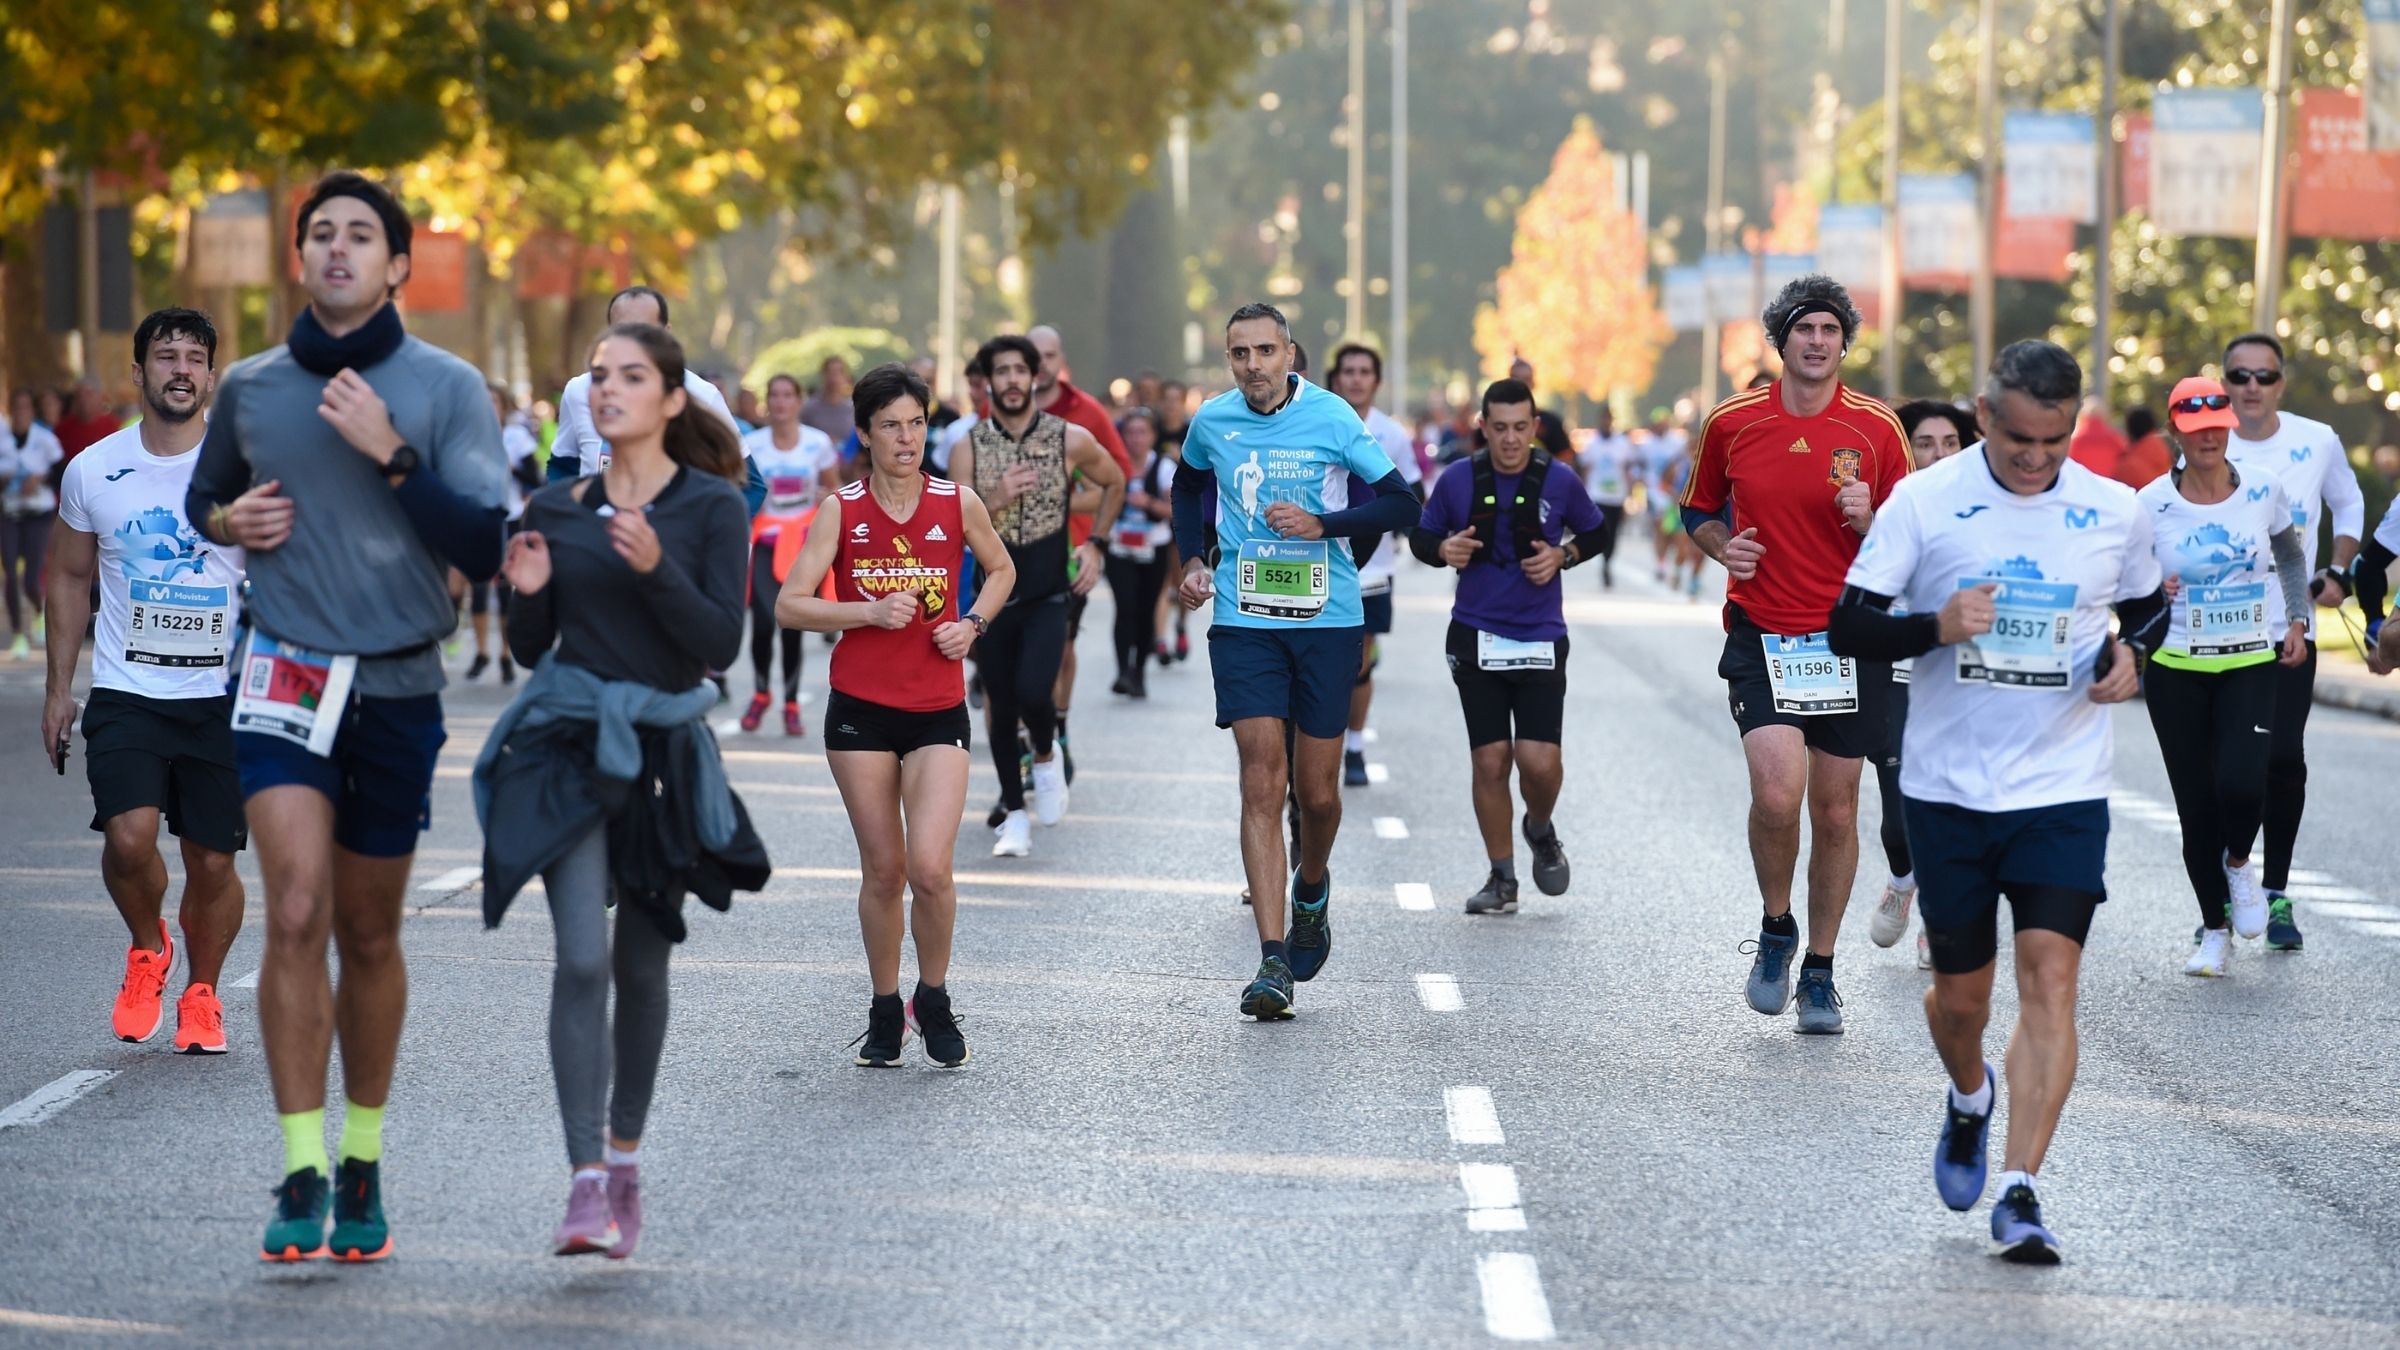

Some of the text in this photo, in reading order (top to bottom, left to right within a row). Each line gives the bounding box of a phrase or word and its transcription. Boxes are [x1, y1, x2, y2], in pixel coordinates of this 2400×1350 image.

[1268, 450, 1315, 459] movistar
[1268, 461, 1300, 470] MEDIO
[1268, 468, 1315, 479] MARATÓN
[1280, 548, 1310, 556] Movistar
[852, 567, 948, 577] MADRID
[1265, 569, 1301, 585] 5521
[174, 592, 210, 601] Movistar
[151, 613, 204, 631] 15229
[2207, 609, 2249, 625] 11616
[1995, 617, 2048, 639] 0537
[1786, 661, 1833, 677] 11596
